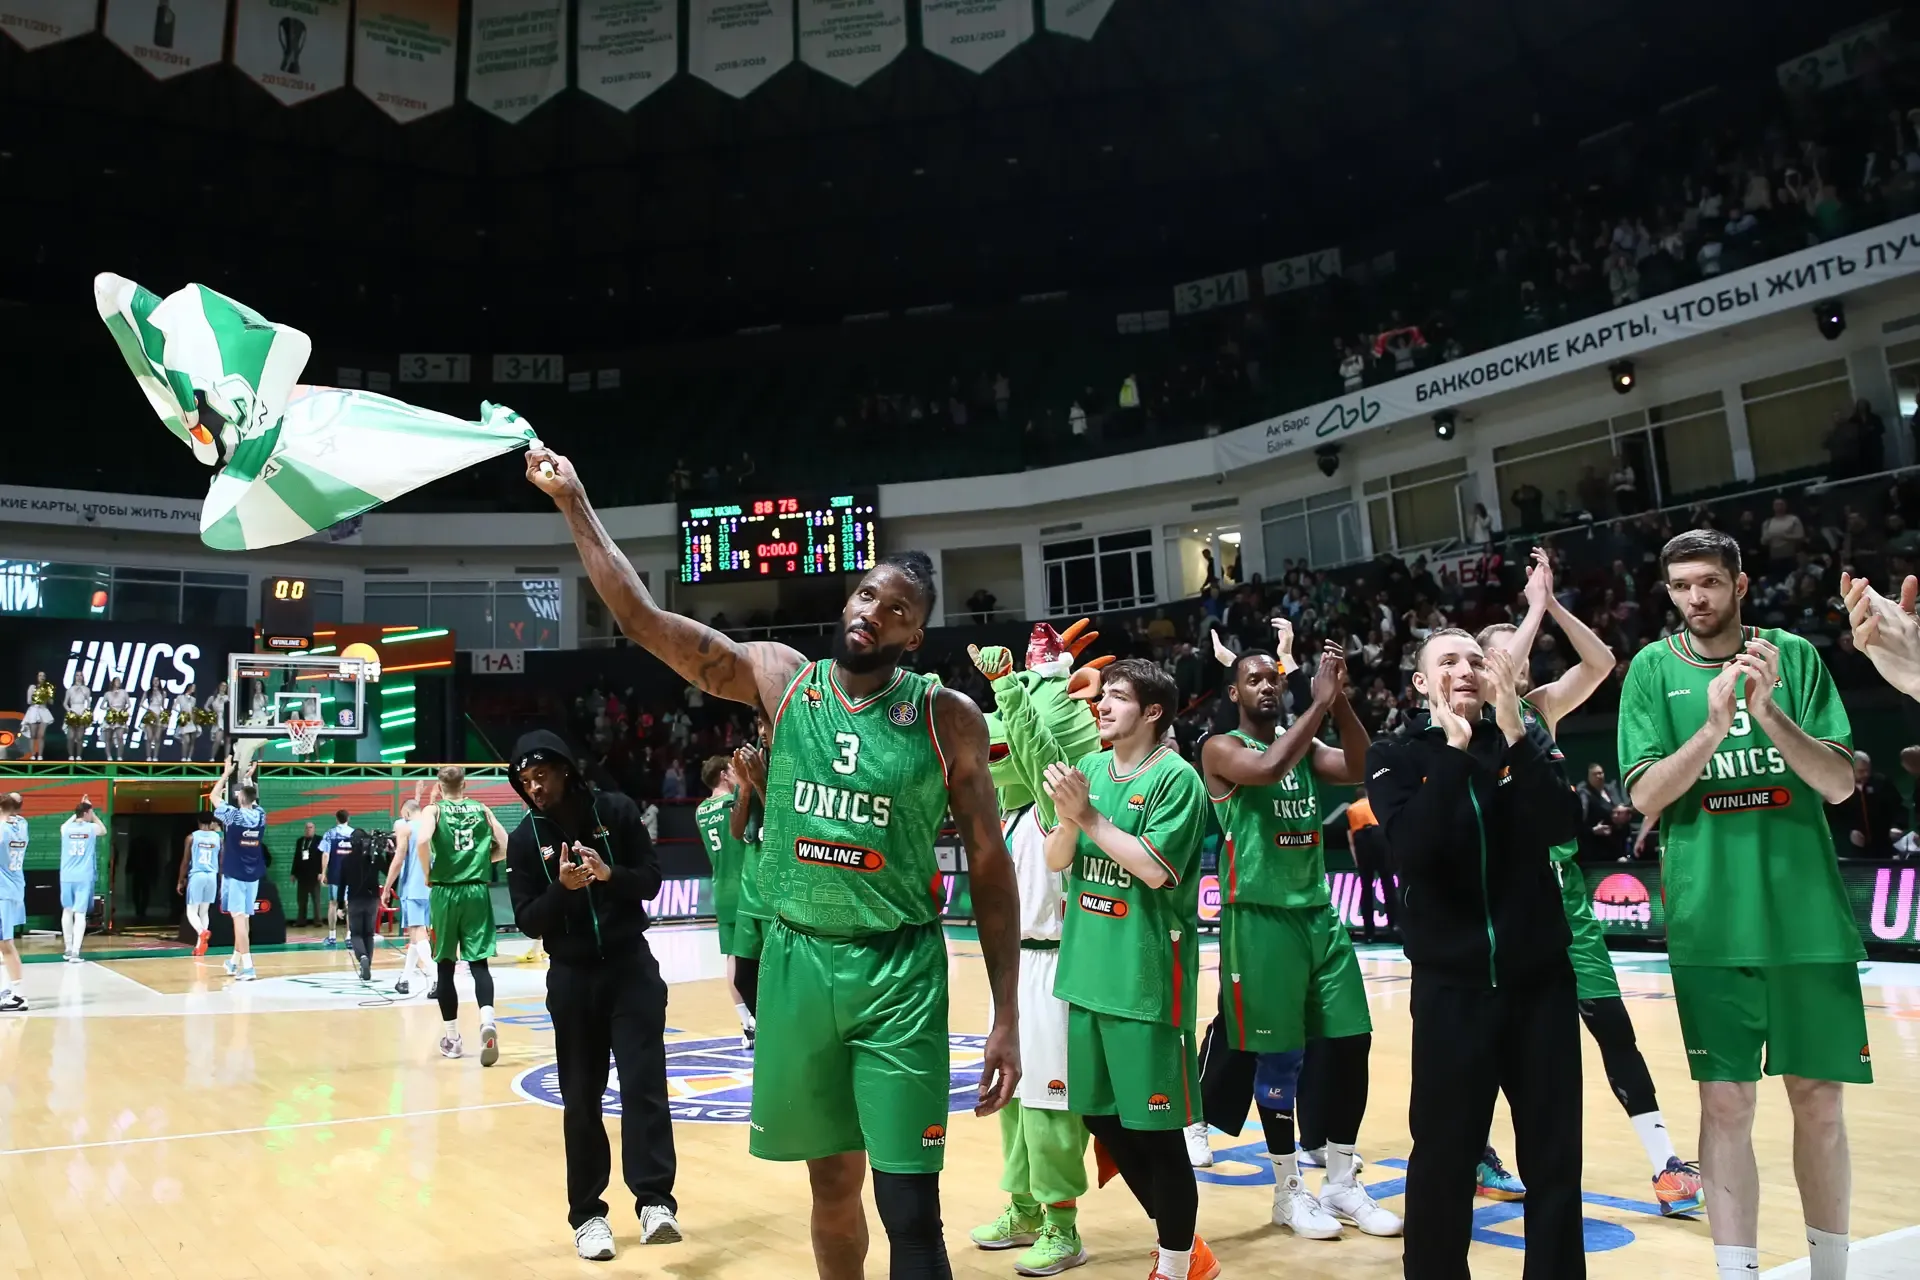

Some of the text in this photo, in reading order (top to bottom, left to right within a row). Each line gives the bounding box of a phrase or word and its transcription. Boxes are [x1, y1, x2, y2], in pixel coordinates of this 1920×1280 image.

[949, 29, 1006, 45] 2021/2022
[1415, 343, 1560, 402] БАНКОВСКИЕ
[1566, 315, 1658, 356] КАРТЫ,
[1663, 282, 1759, 326] ЧТОБЫ
[1766, 255, 1856, 297] ЖИТЬ
[1266, 416, 1310, 437] Ак Барс
[1266, 439, 1294, 453] Банк
[31, 500, 80, 514] КАРТЫ,
[83, 504, 128, 516] ЧТОБЫ
[131, 507, 168, 519] ЖИТЬ
[754, 499, 798, 514] 88 75
[807, 518, 813, 526] 0
[815, 517, 821, 526] 3
[842, 515, 853, 524] 13
[685, 528, 690, 536] 1
[718, 523, 737, 533] 15 1
[772, 527, 780, 539] 4
[808, 527, 812, 535] 1
[842, 524, 853, 533] 20
[855, 522, 862, 532] 2
[685, 537, 691, 545] 3
[692, 535, 699, 544] 4
[718, 534, 729, 542] 21
[842, 531, 874, 542] 23 3 4
[685, 546, 691, 554] 4
[692, 544, 699, 553] 5
[718, 543, 730, 551] 22
[757, 542, 798, 557] 0:00.0
[808, 545, 814, 554] 9
[816, 544, 822, 554] 4
[842, 543, 854, 551] 33
[685, 555, 691, 563] 5
[693, 554, 700, 563] 3
[718, 552, 730, 561] 27
[731, 550, 738, 560] 2
[804, 555, 814, 564] 10
[816, 554, 822, 563] 5
[843, 552, 854, 561] 35
[856, 550, 862, 560] 1
[681, 564, 692, 573] 12
[693, 562, 699, 571] 1
[719, 561, 730, 570] 95
[731, 560, 739, 569] 2
[787, 561, 795, 572] 3
[804, 564, 815, 574] 12
[817, 562, 823, 572] 1
[843, 561, 855, 571] 99
[856, 560, 863, 570] 4
[681, 572, 700, 582] 13 2
[63, 640, 201, 694] UNICS
[1667, 688, 1691, 697] MAXX
[1724, 698, 1753, 739] 5
[832, 730, 861, 775] 3
[794, 778, 893, 827] UNICS
[1708, 791, 1769, 810] WINLINE
[454, 829, 474, 851] 13
[708, 828, 722, 851] 5
[68, 841, 86, 856] 33
[798, 842, 864, 865] WINLINE
[199, 850, 213, 865] 20
[1593, 901, 1651, 922] UNICS
[1148, 1102, 1171, 1111] UNICS
[922, 1137, 946, 1147] UNICS
